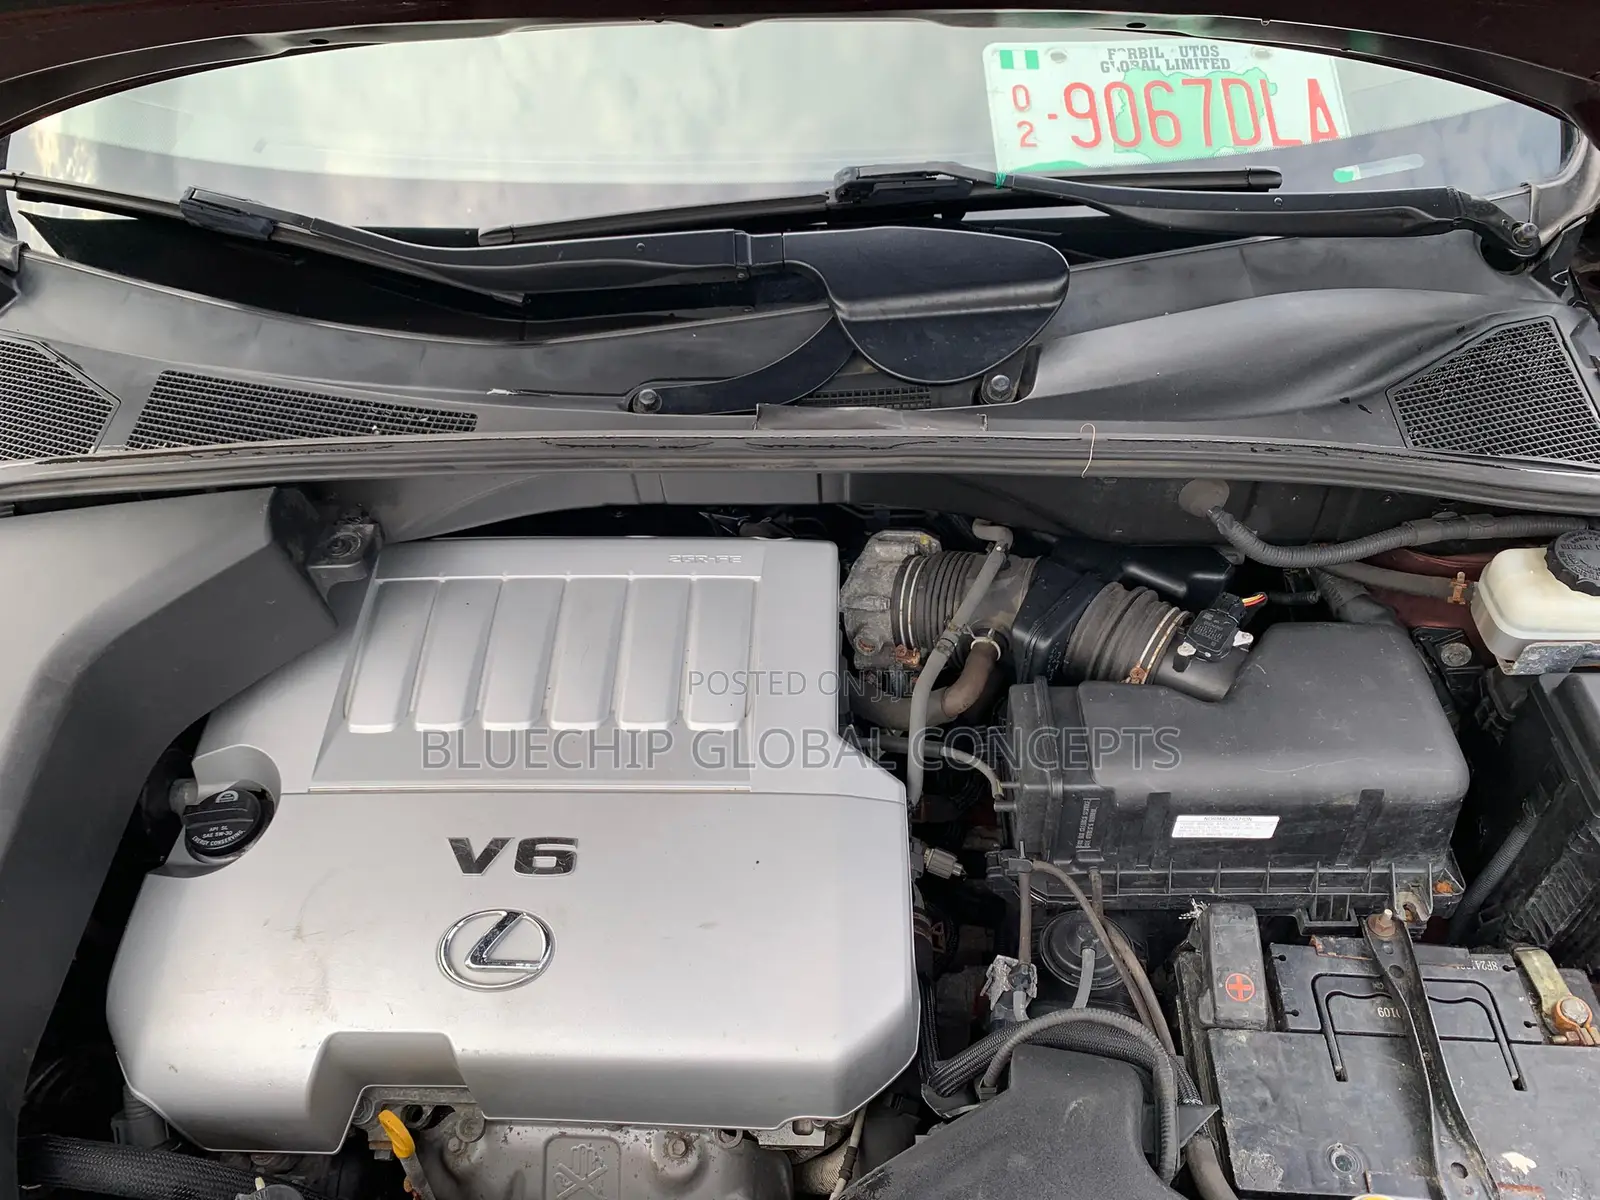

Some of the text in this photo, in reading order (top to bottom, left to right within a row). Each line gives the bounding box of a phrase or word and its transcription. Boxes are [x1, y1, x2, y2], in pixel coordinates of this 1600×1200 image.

[1107, 46, 1165, 60] FRBIL
[1164, 58, 1231, 71] LIMITED
[191, 835, 209, 846] ENERGY
[446, 836, 579, 877] V6
